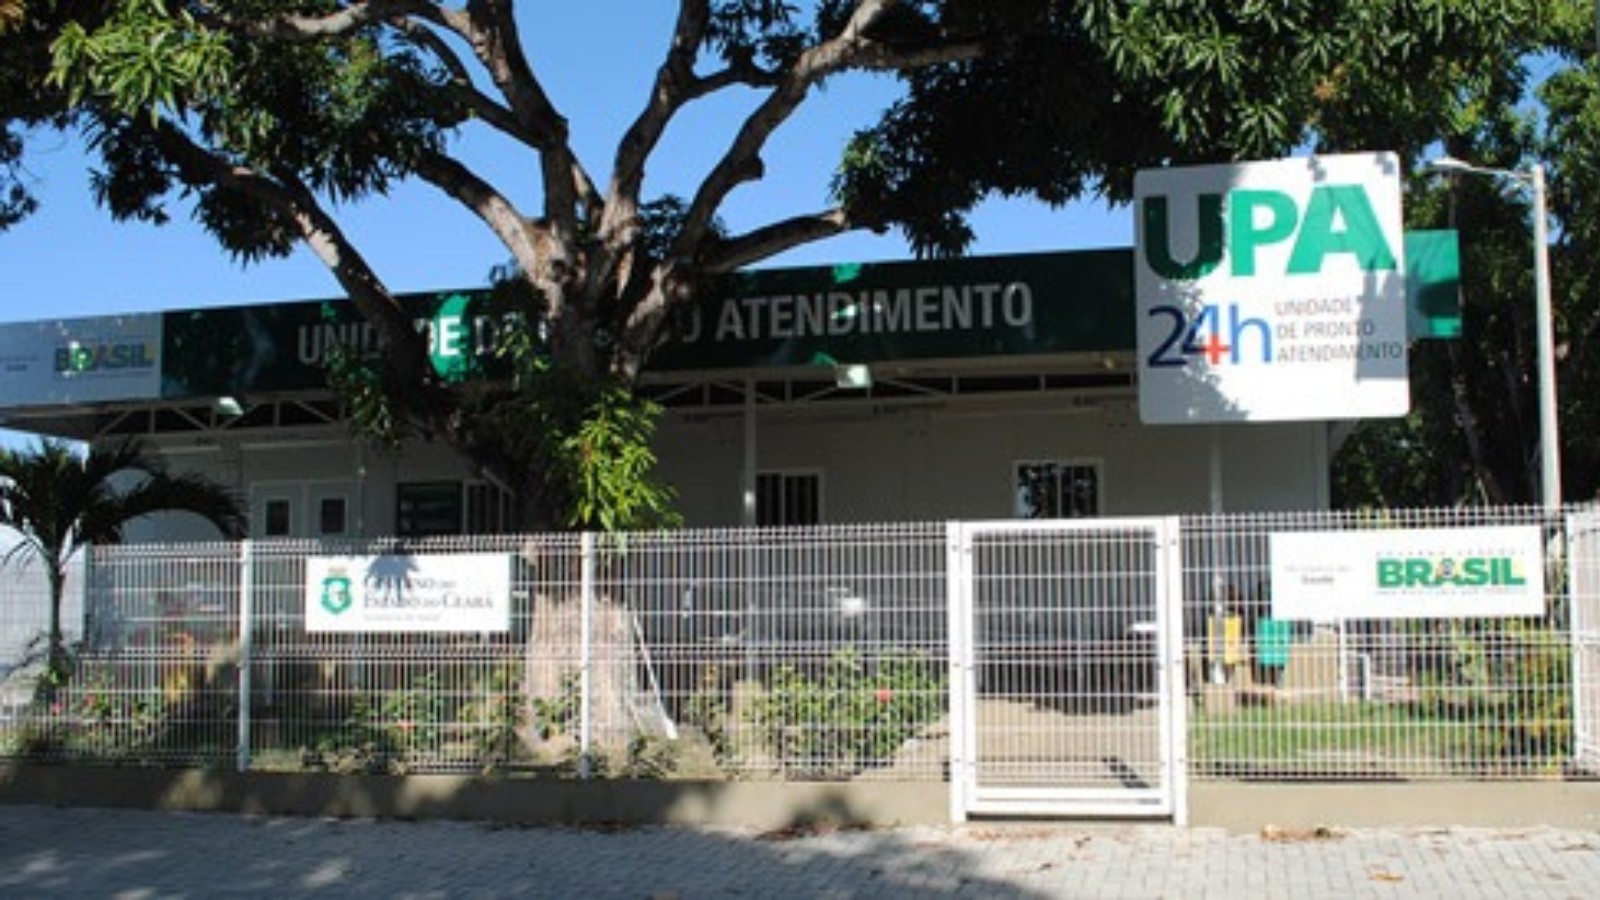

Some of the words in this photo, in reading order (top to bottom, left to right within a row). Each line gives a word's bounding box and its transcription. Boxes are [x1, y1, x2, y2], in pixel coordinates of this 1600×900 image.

[1143, 184, 1397, 281] UPA
[1274, 296, 1353, 316] UNIDADE
[297, 315, 462, 364] UNIDDE
[715, 281, 1033, 341] ATENDIMENTO
[1276, 322, 1298, 339] DE
[1303, 318, 1376, 338] PRONTO
[1147, 303, 1273, 369] 24h
[1276, 341, 1404, 363] ATENDIMENTO
[1376, 557, 1527, 588] BRASIL
